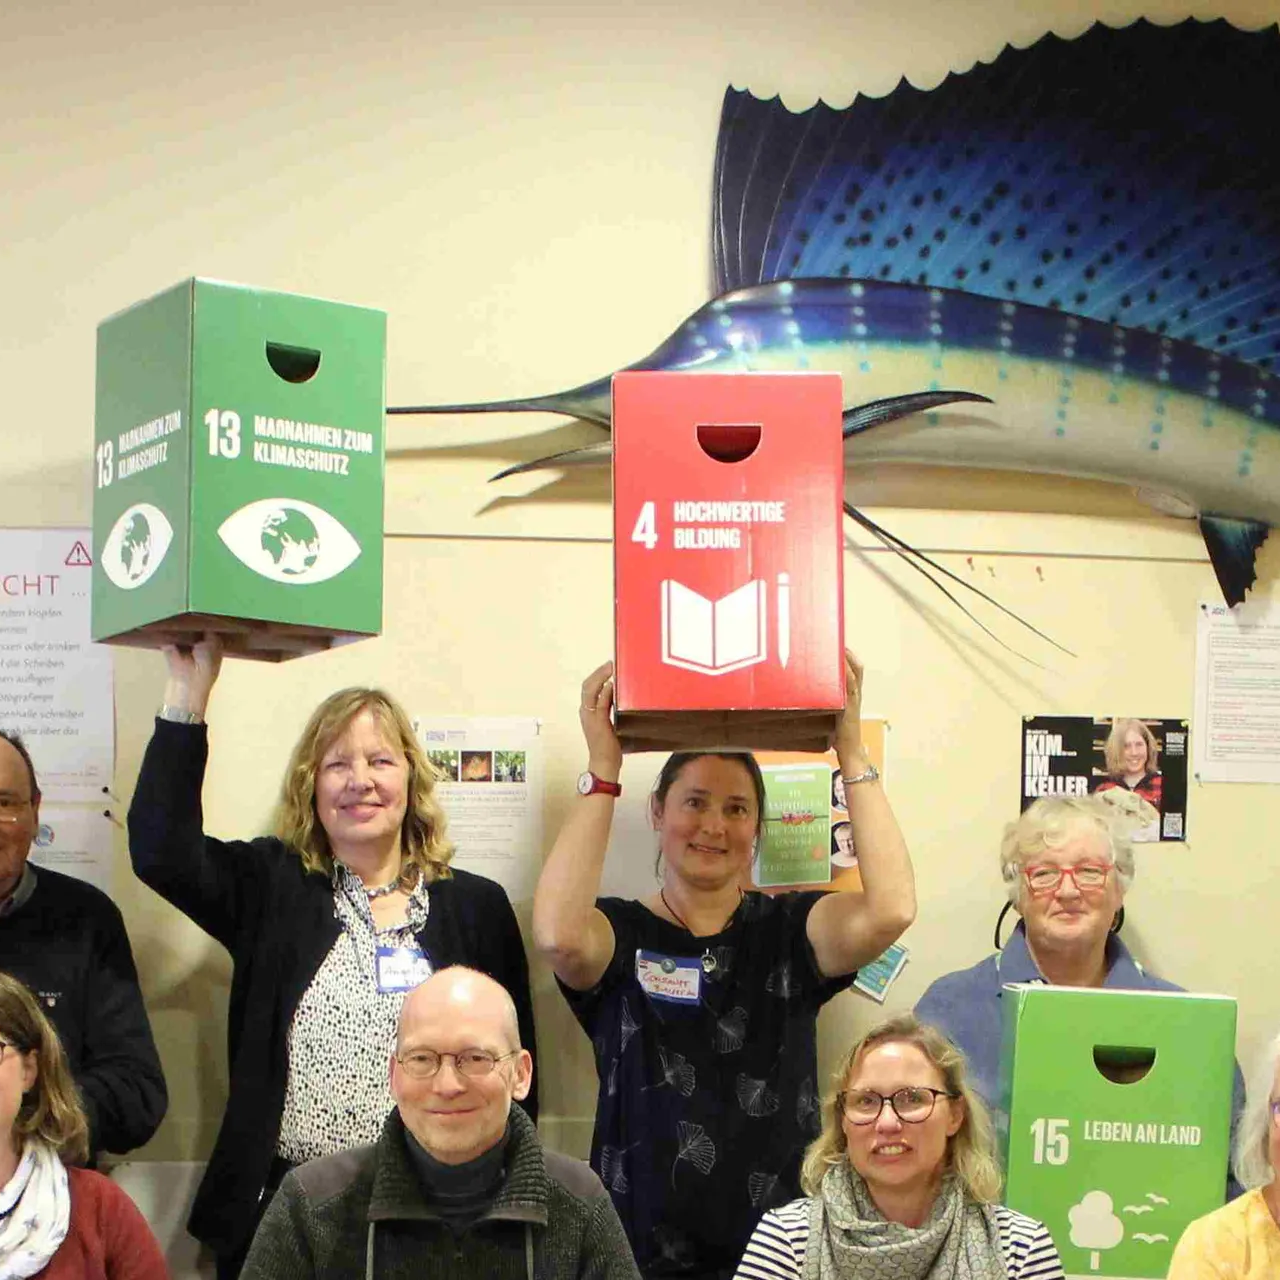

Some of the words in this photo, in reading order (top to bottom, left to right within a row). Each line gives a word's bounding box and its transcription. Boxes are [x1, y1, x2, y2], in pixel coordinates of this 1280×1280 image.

[204, 408, 241, 459] 13
[344, 431, 373, 454] ZUM
[96, 440, 113, 489] 13
[253, 441, 350, 476] KLIMASCHUTZ
[632, 501, 658, 549] 4
[674, 501, 785, 523] HOCHWERTIGE
[674, 528, 741, 549] BILDUNG
[1025, 734, 1062, 756] KIM
[1025, 756, 1049, 776] IM
[1025, 776, 1088, 797] KELLER
[1030, 1118, 1069, 1165] 15
[1084, 1120, 1132, 1142] LEBEN
[1135, 1124, 1158, 1144] AN
[1160, 1124, 1201, 1147] LAND
